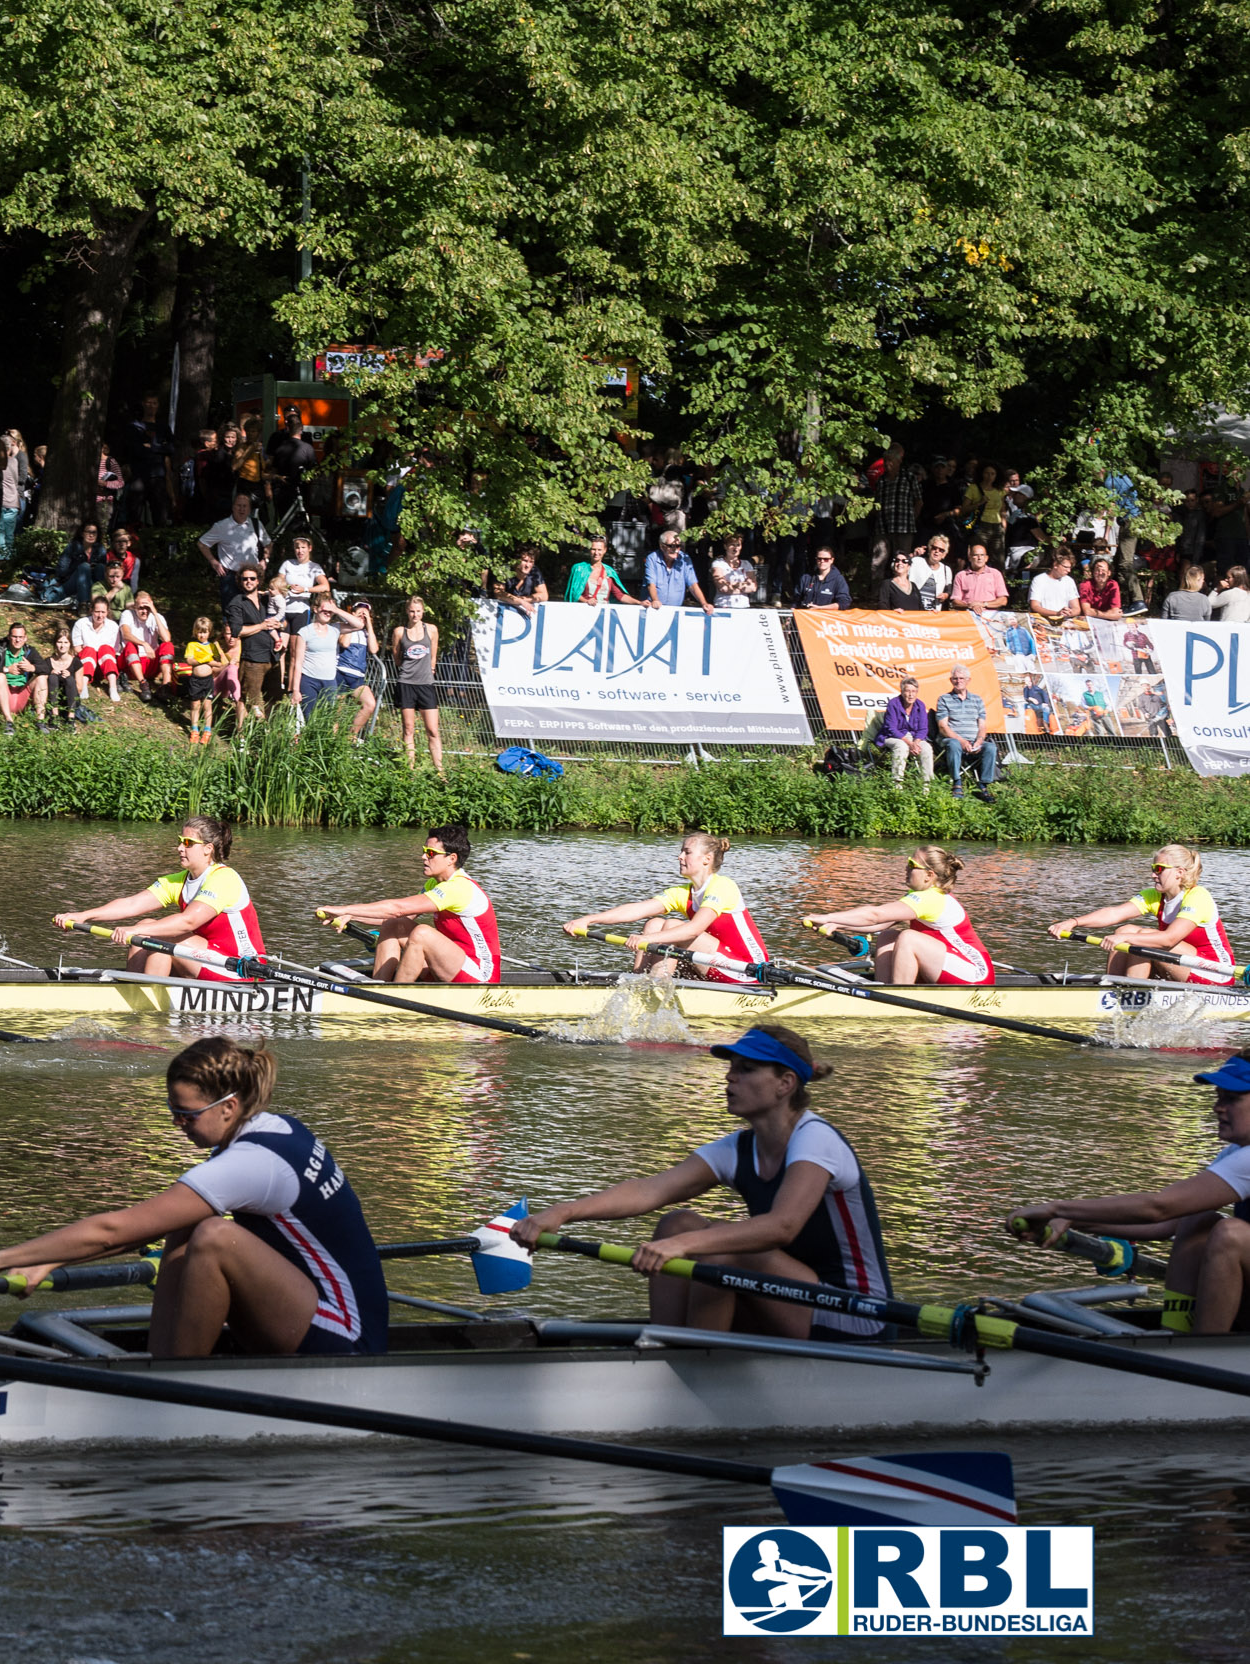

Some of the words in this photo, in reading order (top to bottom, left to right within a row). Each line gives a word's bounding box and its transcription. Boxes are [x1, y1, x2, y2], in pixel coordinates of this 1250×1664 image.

[491, 604, 731, 680] PLANAT
[853, 624, 900, 638] miete
[902, 626, 941, 640] alles
[758, 613, 790, 703] www.planat.de
[827, 641, 905, 661] benötigte
[908, 644, 975, 660] Material
[834, 662, 860, 677] bei
[498, 685, 580, 701] consulting
[598, 687, 667, 702] software
[686, 690, 742, 703] service
[504, 719, 534, 728] FEPA:
[587, 722, 631, 731] Software
[632, 724, 647, 732] für
[670, 725, 746, 736] produzierenden
[747, 725, 800, 735] Mittelstand
[179, 986, 314, 1012] MINDEN
[474, 987, 515, 1009] Melitta
[964, 988, 1002, 1008] Melitta
[722, 1274, 760, 1292] STARK.
[762, 1282, 815, 1303] SCHNELL.
[815, 1293, 842, 1308] GUT.
[856, 1302, 878, 1314] RBL
